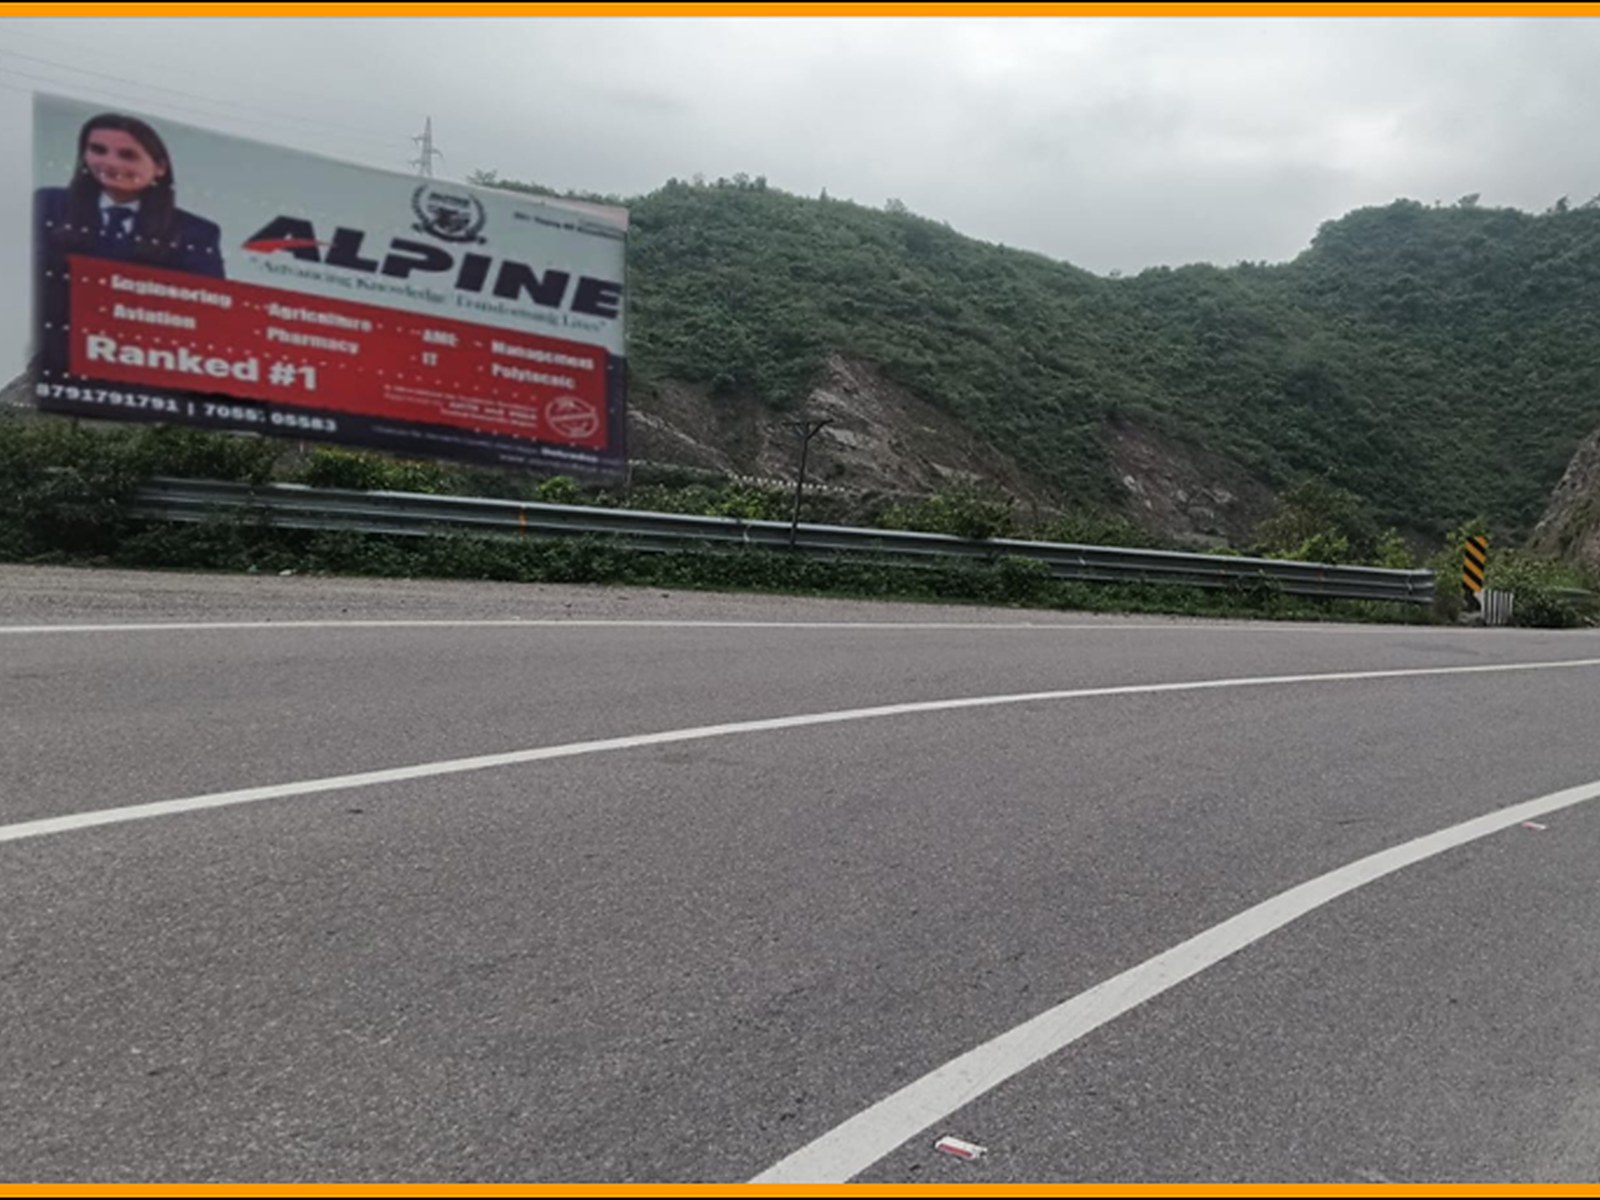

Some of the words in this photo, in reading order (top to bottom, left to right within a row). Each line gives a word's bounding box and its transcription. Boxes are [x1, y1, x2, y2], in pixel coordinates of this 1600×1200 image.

[241, 215, 622, 319] ALPINE
[111, 273, 233, 309] Engineering
[113, 303, 197, 330] Aviation
[267, 302, 372, 332] Agriculture
[266, 326, 359, 355] Pharmacy
[491, 340, 595, 371] Management
[86, 334, 259, 384] Ranked
[268, 360, 317, 391] #1
